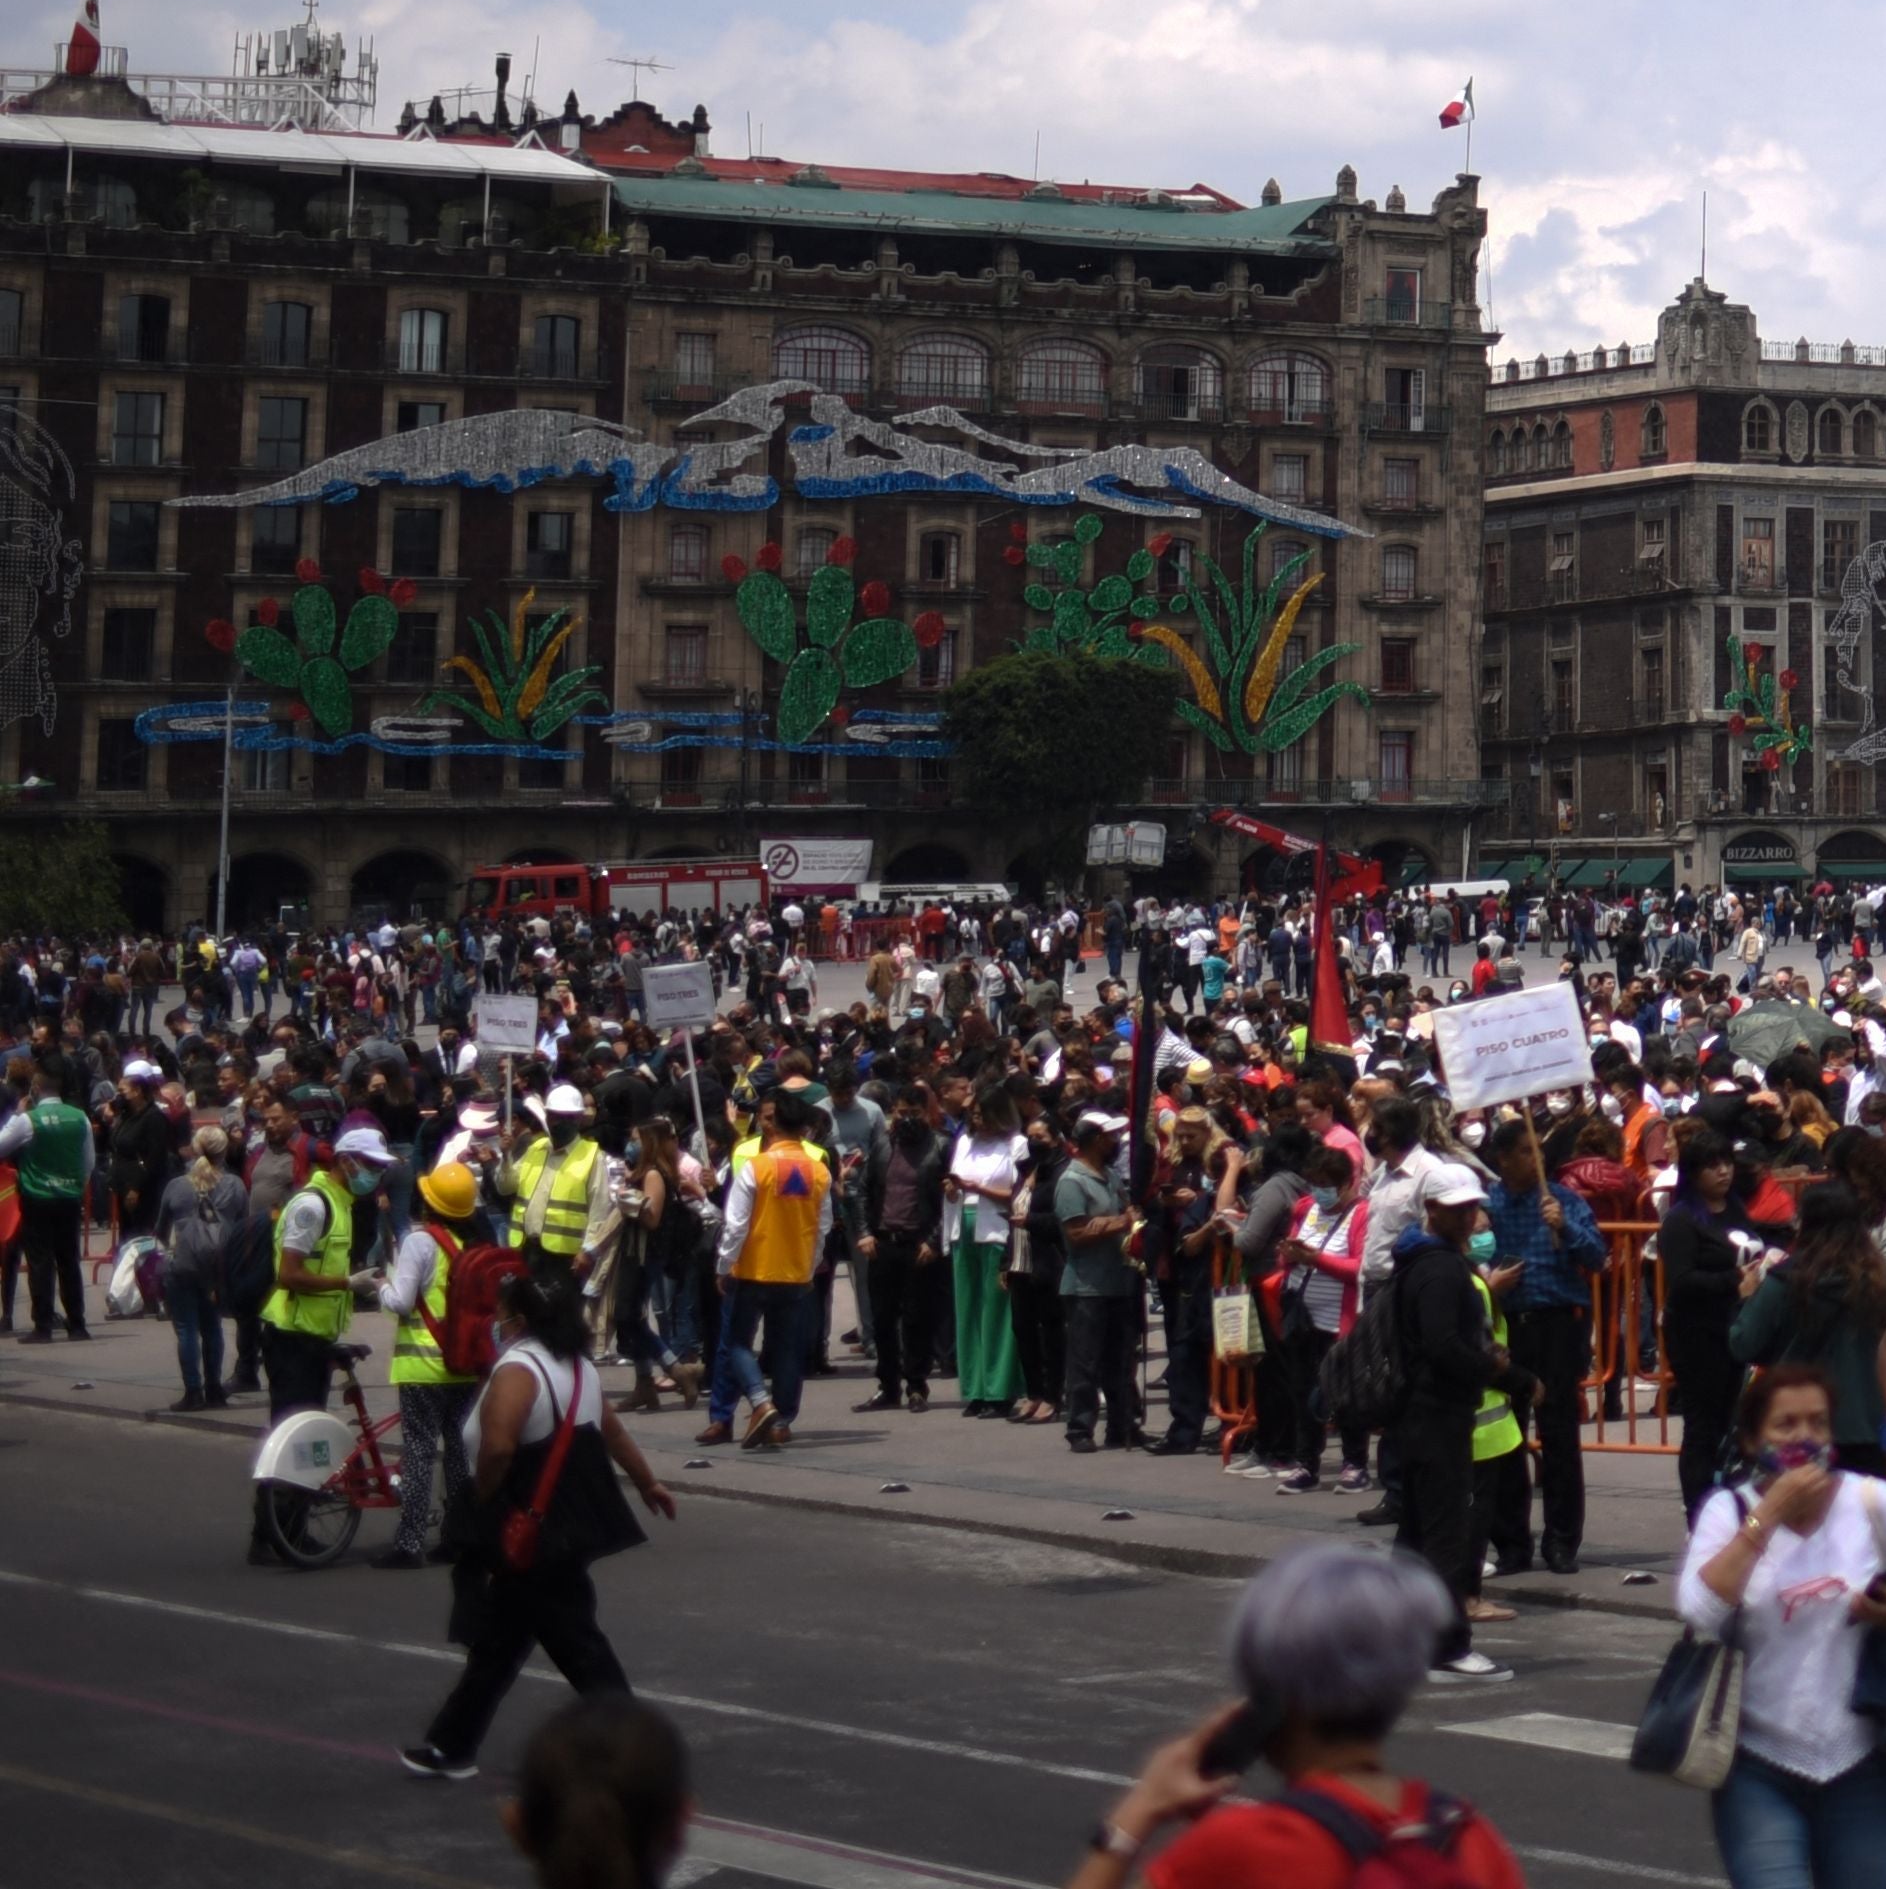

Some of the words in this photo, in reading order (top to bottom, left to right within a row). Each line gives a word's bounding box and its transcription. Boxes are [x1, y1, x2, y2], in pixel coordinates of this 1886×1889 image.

[1726, 847, 1793, 860] BIZZARRO
[656, 991, 677, 1002] PISO
[677, 989, 699, 1000] TRES
[487, 1017, 507, 1027] PISO
[508, 1019, 528, 1029] TRES
[1475, 1041, 1509, 1057] PISO
[1511, 1028, 1570, 1049] CUATRO
